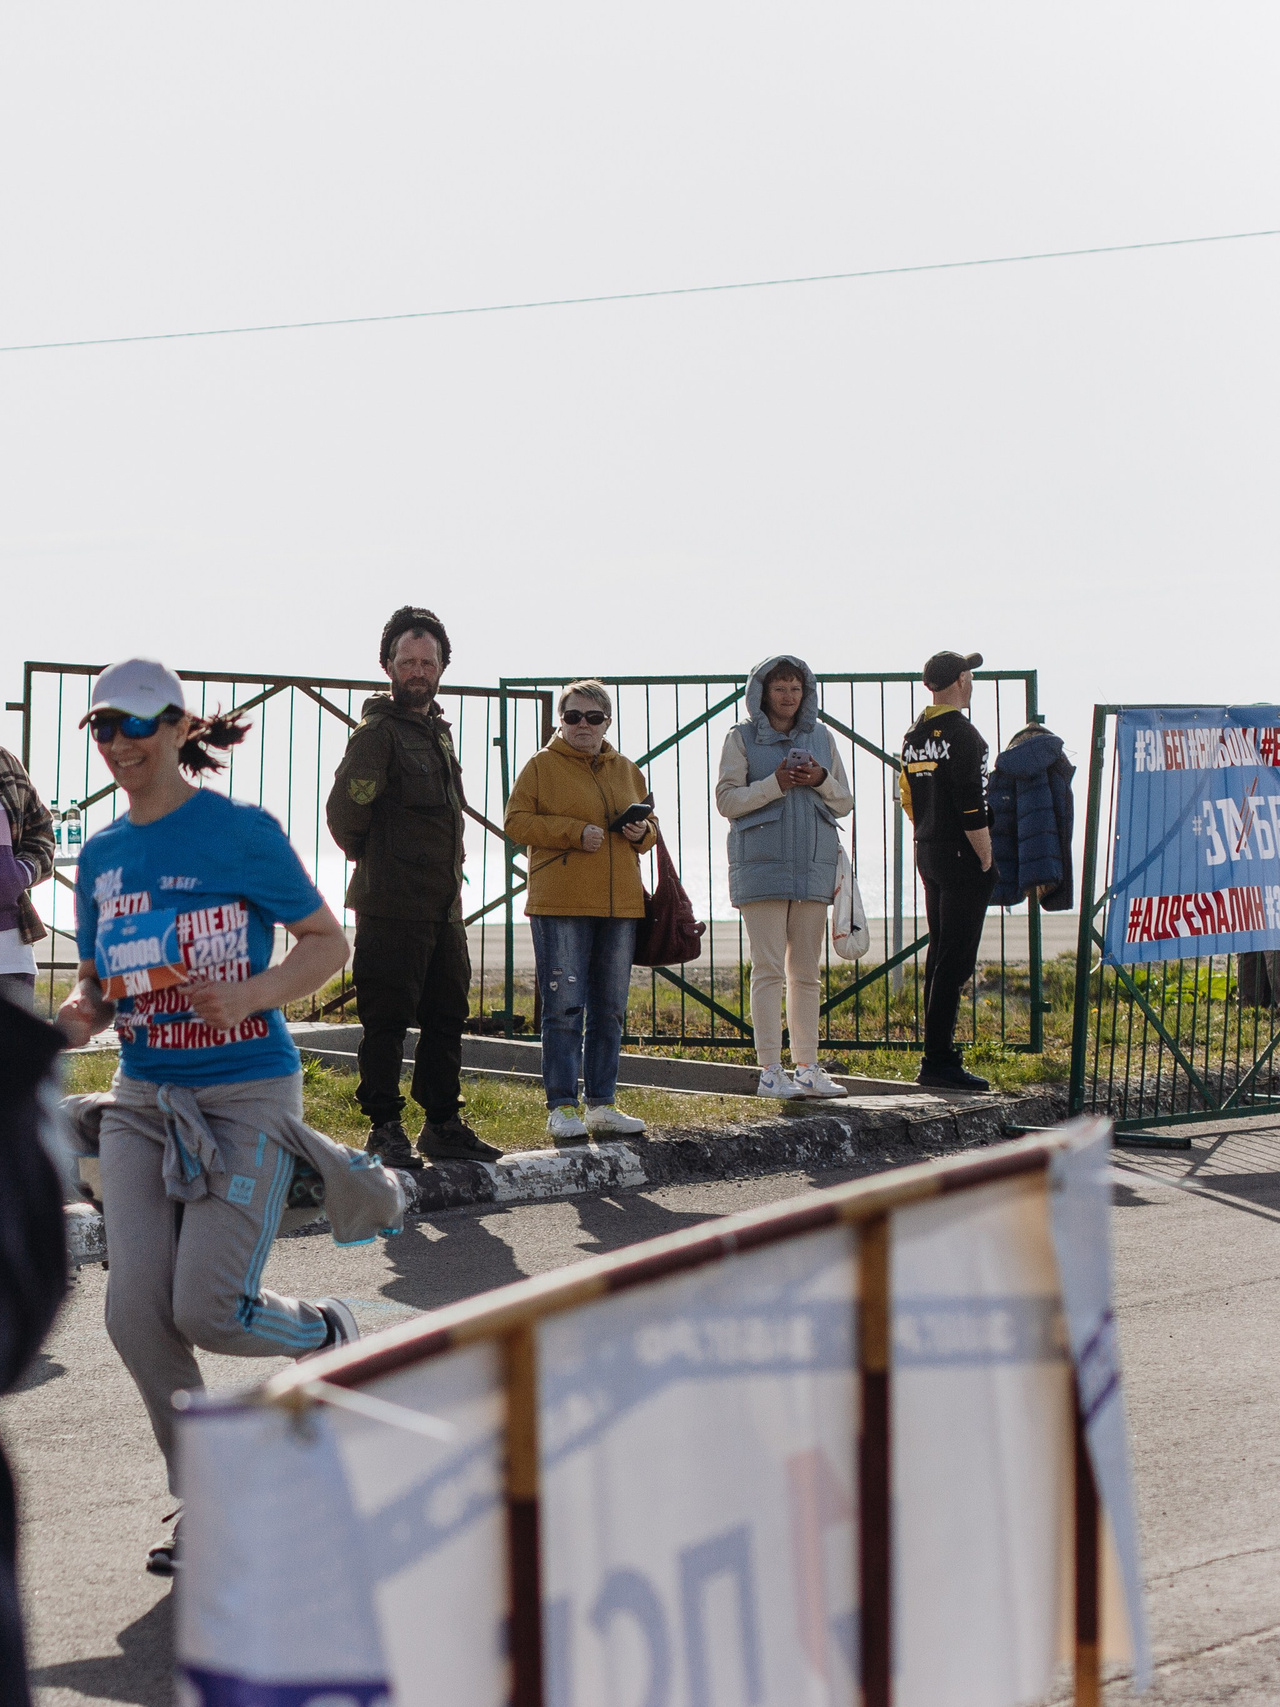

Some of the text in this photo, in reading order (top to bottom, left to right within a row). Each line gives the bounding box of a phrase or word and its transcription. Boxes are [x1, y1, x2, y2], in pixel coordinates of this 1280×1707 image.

[1135, 729, 1189, 772] #ЗАБЕГ
[177, 900, 248, 947] #ЦЕЛЬ
[1125, 886, 1267, 943] #АДРЕНАЛИН
[194, 929, 248, 968] 2024
